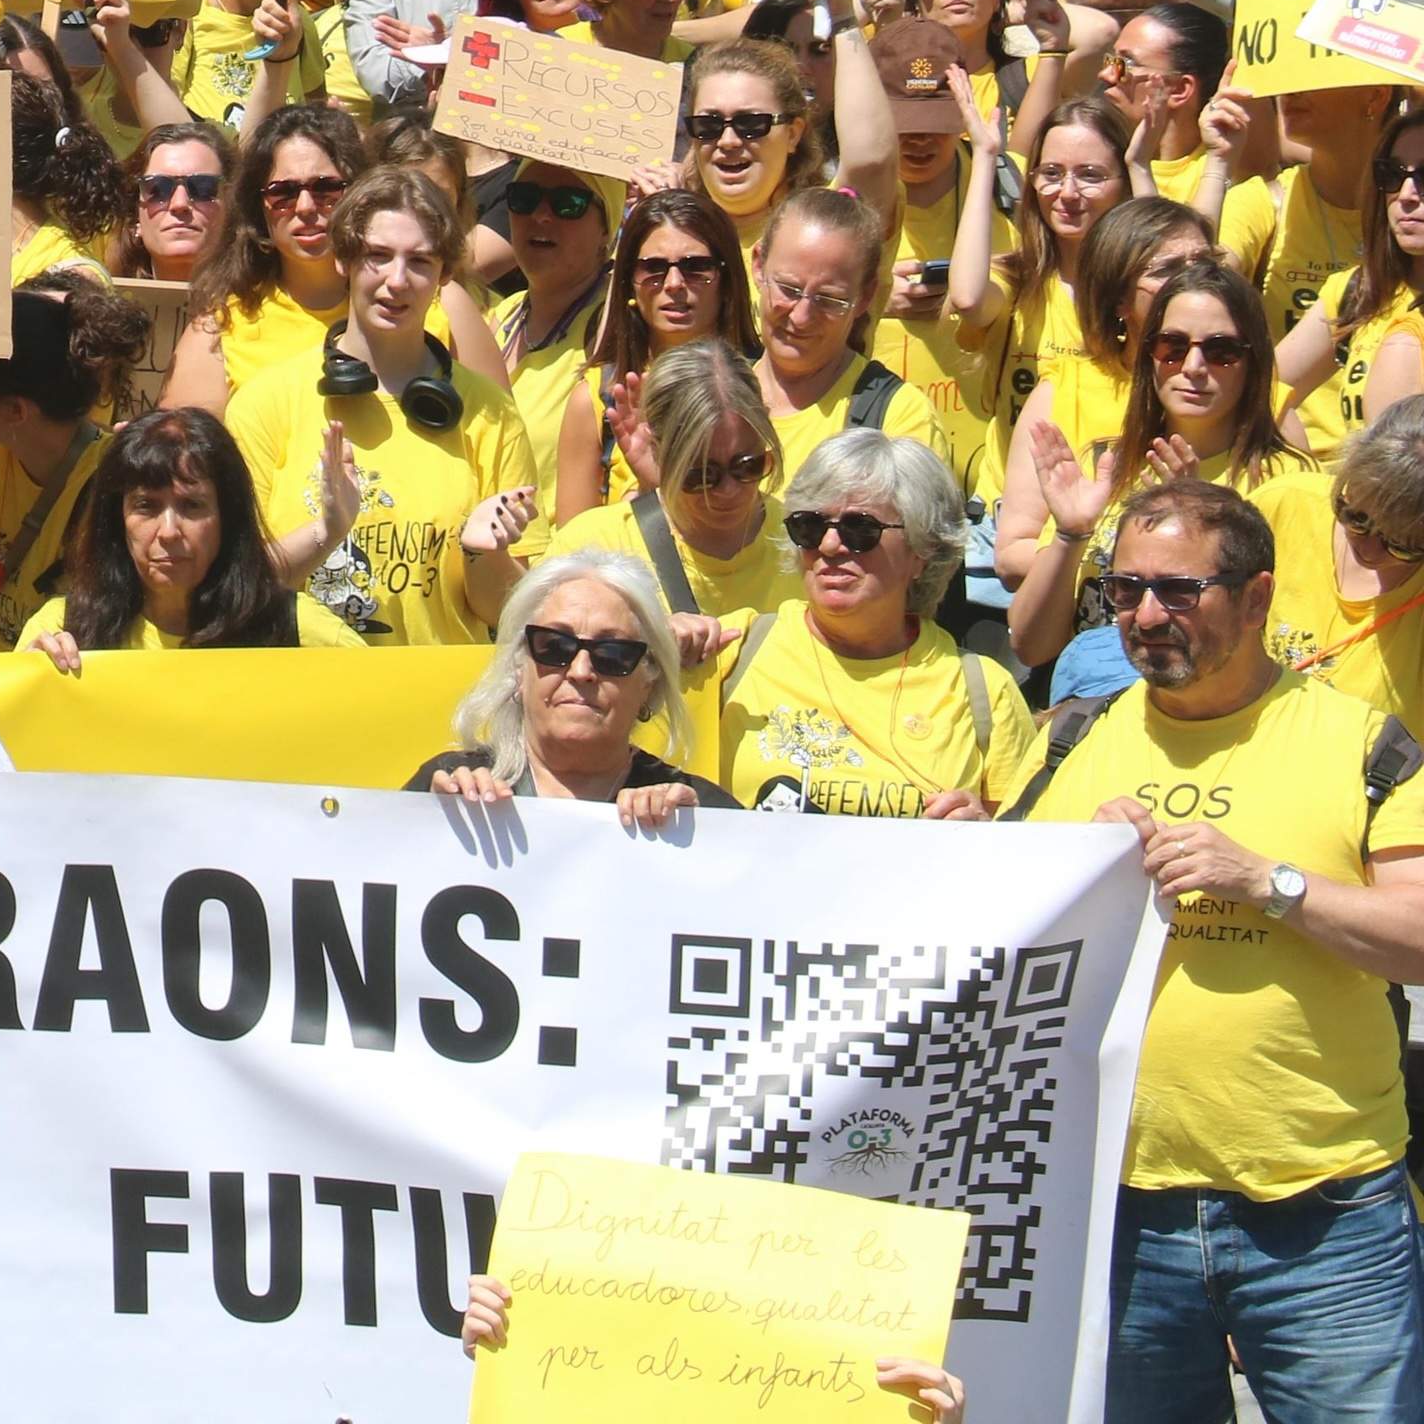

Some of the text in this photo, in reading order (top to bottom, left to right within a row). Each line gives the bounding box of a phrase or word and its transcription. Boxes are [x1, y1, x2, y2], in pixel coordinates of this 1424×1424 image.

[500, 39, 675, 117] RECURSOS
[1136, 782, 1233, 820] SOS
[819, 1108, 917, 1144] PLATAFORMA
[109, 1167, 498, 1339] FUTU
[538, 1337, 865, 1410] per als infants
